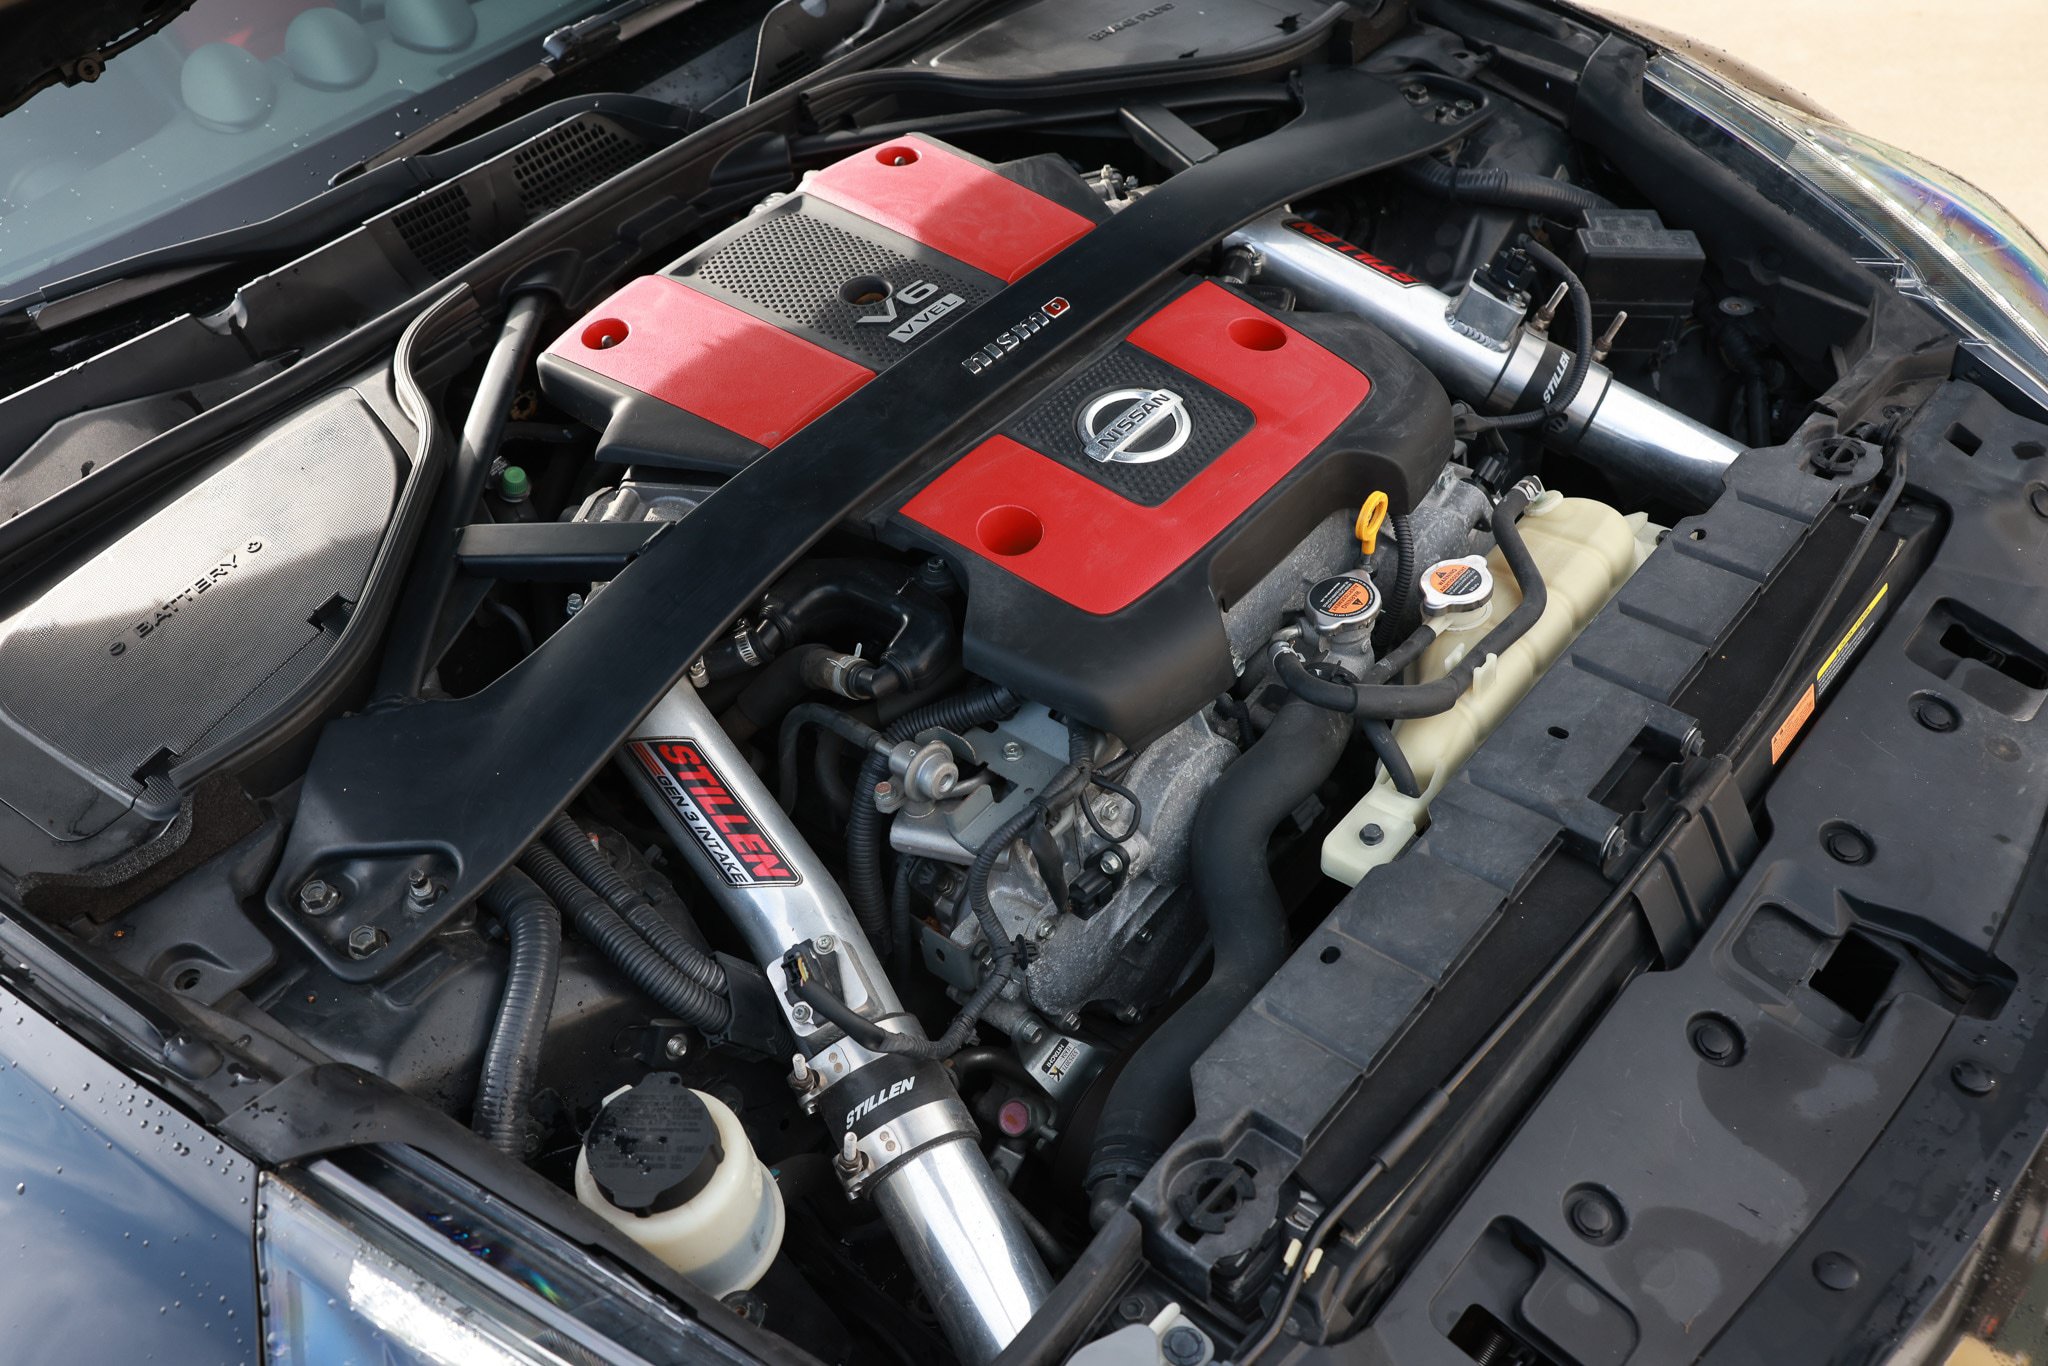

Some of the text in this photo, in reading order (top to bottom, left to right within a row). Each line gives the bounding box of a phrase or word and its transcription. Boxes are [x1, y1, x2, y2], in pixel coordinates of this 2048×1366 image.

[855, 279, 939, 324] V6
[898, 298, 958, 336] VVEL
[1543, 351, 1570, 404] STILLEN
[1096, 393, 1171, 450] NISSAN
[134, 554, 238, 639] BATTERY
[656, 775, 749, 884] GEN 3 INTAKE
[658, 743, 792, 878] STILLEN
[1046, 1044, 1065, 1068] HITACHI
[846, 1075, 916, 1130] STILLEN
